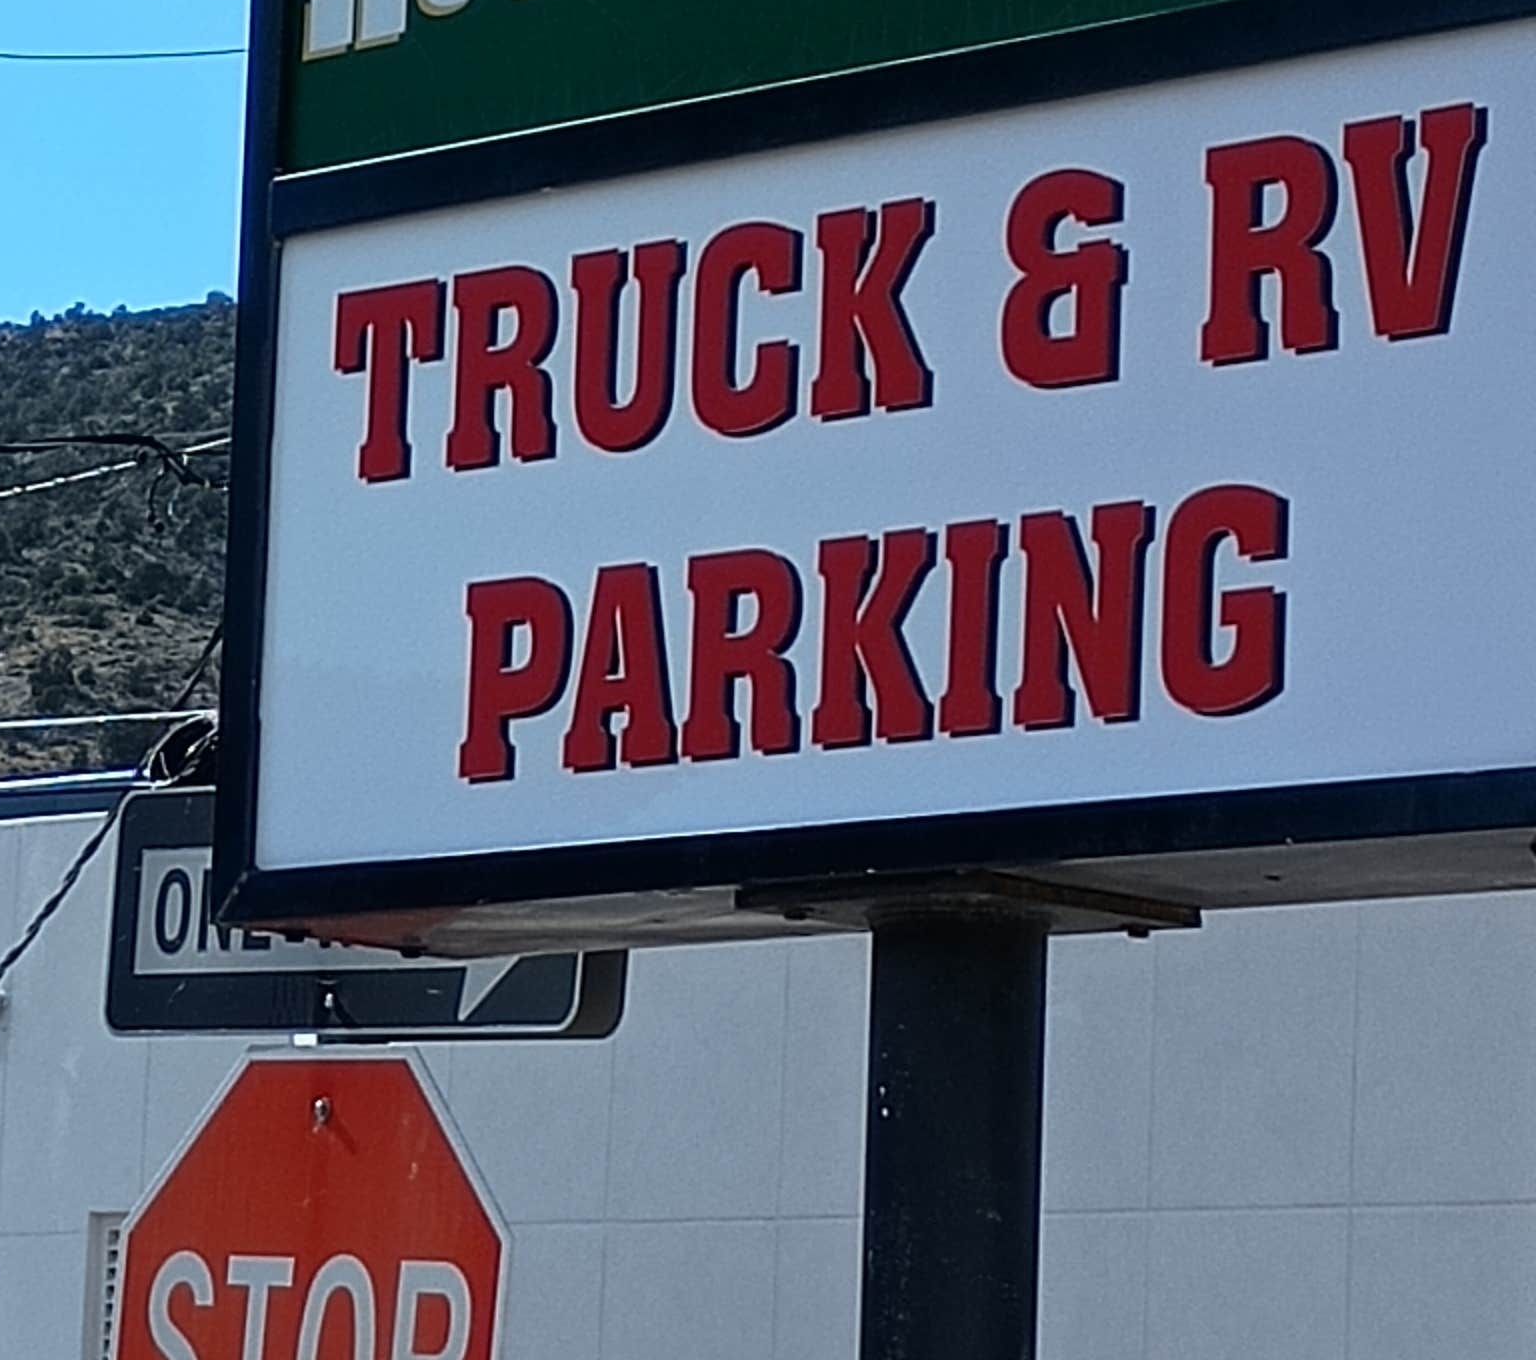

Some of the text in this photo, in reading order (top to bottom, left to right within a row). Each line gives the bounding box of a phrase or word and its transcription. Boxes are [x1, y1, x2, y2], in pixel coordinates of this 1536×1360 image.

[332, 103, 1488, 482] TRUCK & RV
[458, 485, 1290, 783] PARKING
